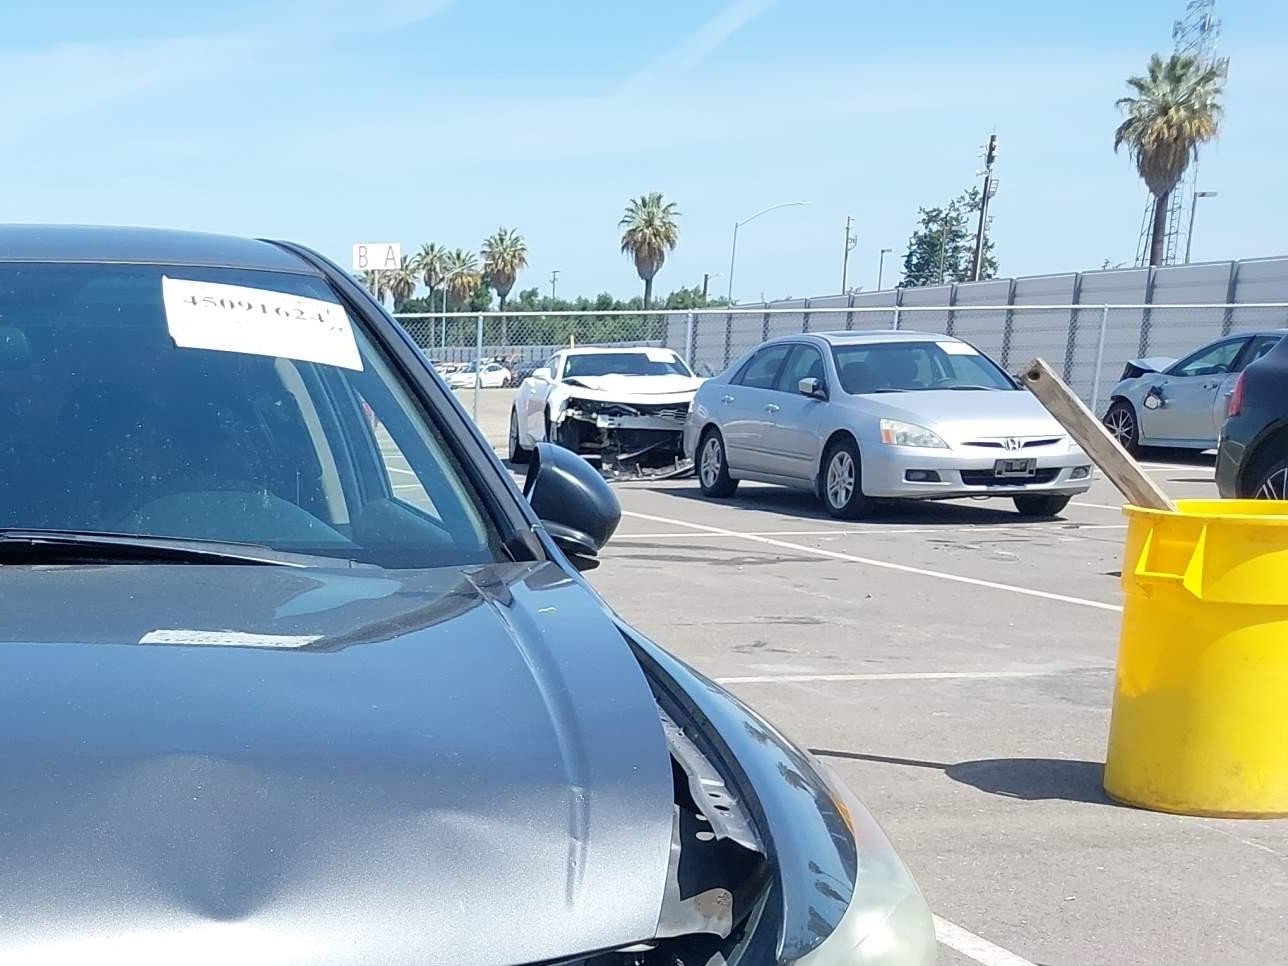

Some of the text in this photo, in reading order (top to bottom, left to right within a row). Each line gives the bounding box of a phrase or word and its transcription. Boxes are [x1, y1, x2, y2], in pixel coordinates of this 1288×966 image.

[358, 244, 397, 268] B A
[184, 295, 324, 323] 45091624
